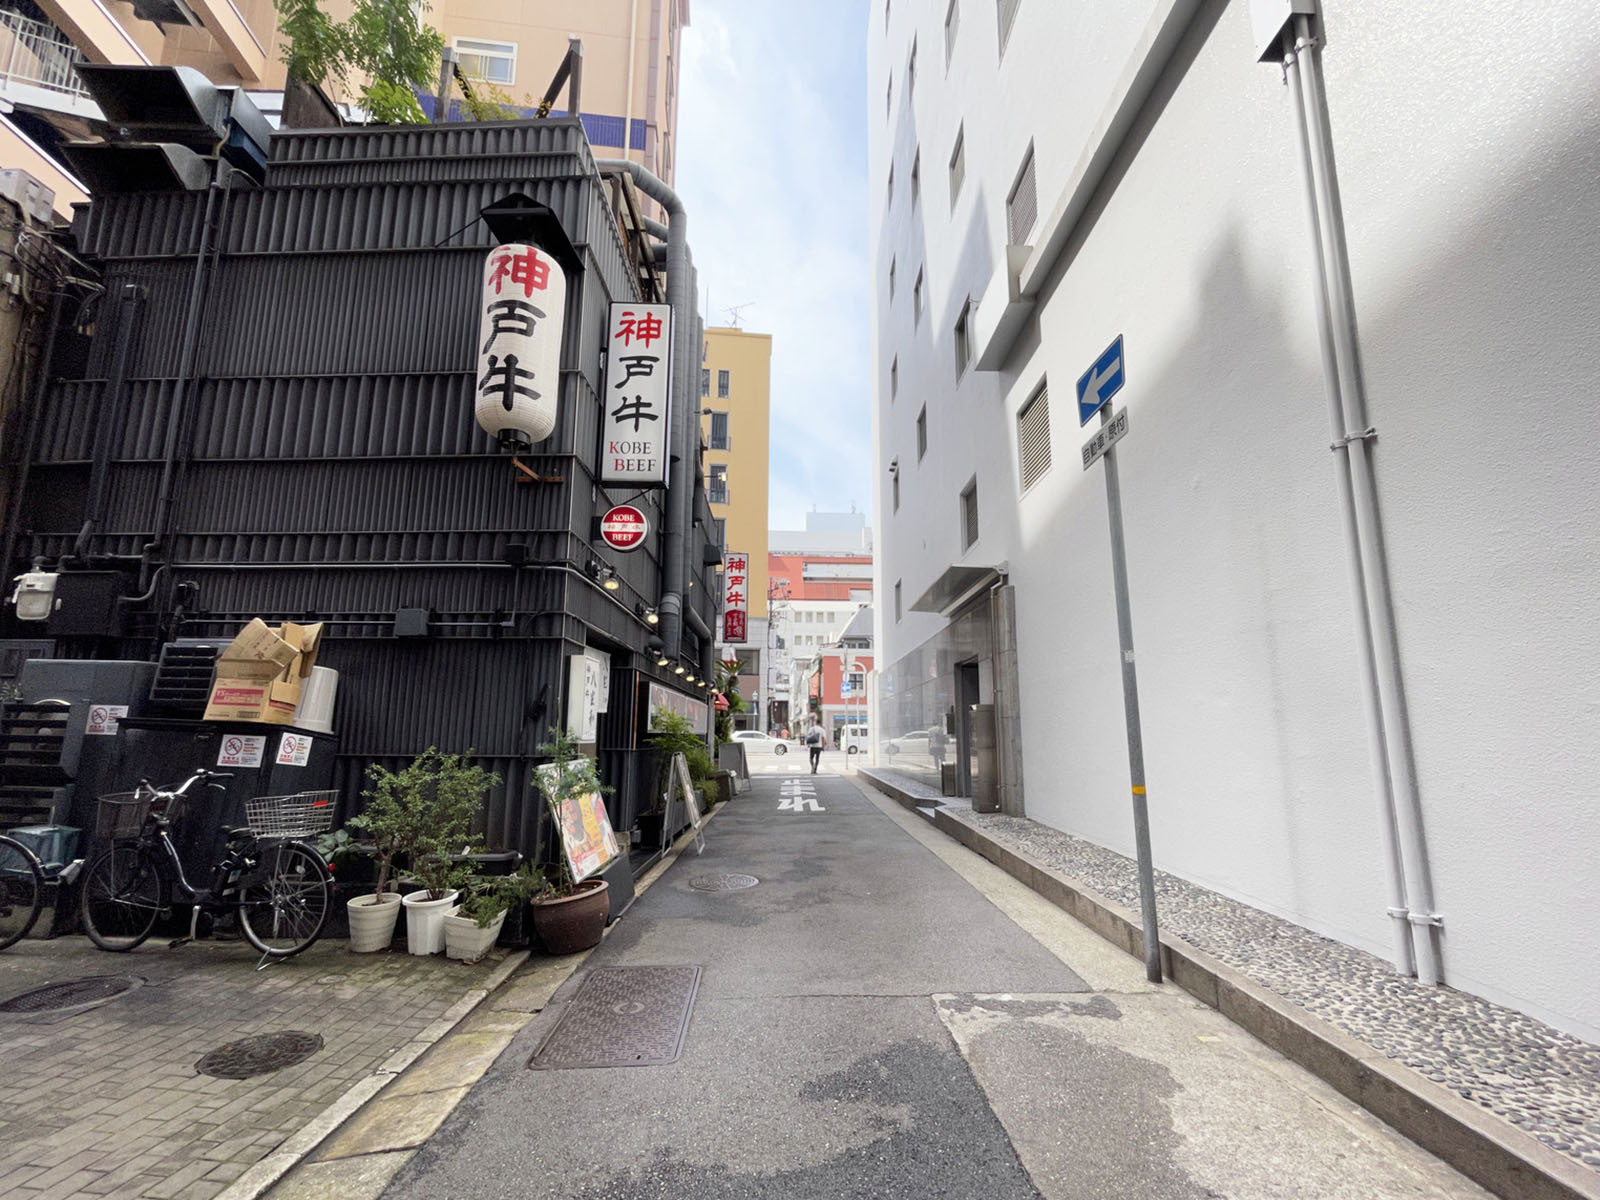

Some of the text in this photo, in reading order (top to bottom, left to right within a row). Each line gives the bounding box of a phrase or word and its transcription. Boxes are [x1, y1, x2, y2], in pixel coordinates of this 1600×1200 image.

[478, 245, 551, 412] 神戸牛
[611, 311, 663, 433] 神戸牛
[609, 440, 652, 455] KOBE
[614, 456, 657, 472] BEEF
[612, 514, 635, 522] KOBE
[612, 533, 634, 541] BEEF
[726, 557, 746, 608] 神戸牛
[776, 778, 826, 812] 止まれ
